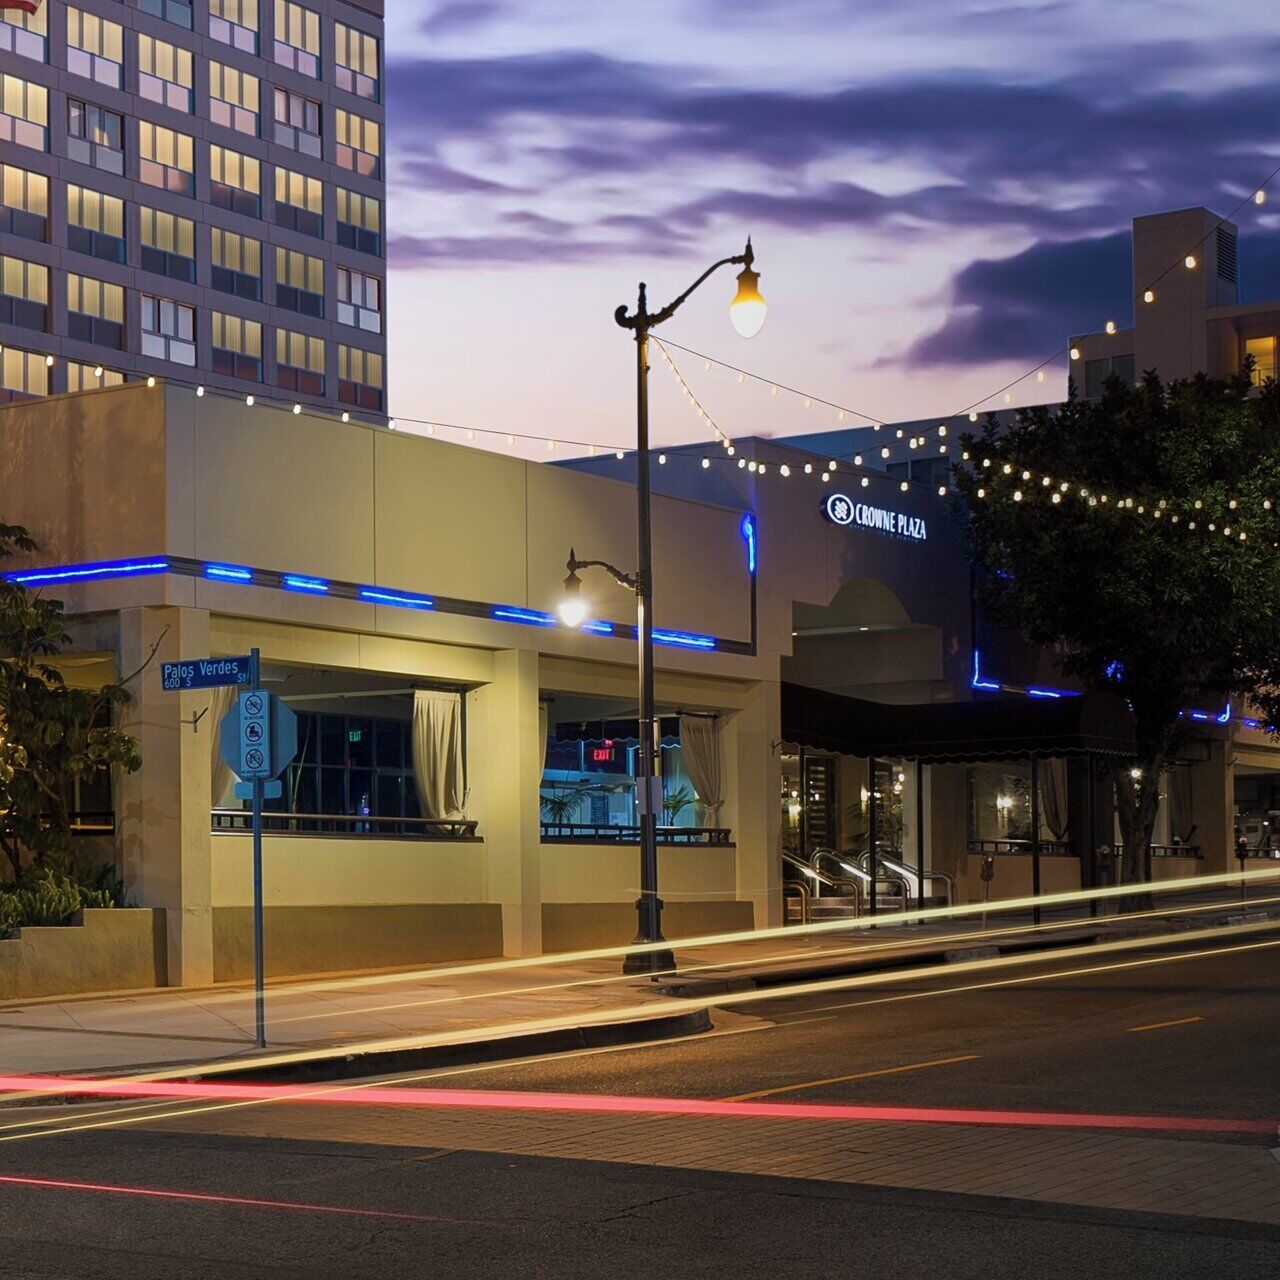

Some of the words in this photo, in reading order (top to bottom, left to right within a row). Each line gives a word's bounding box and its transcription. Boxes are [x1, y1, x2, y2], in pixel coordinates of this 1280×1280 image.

[855, 503, 896, 533] CROWNE
[897, 513, 927, 540] PLAZA
[164, 664, 194, 679] Palos
[199, 660, 238, 677] Verdes
[164, 678, 181, 689] 600
[186, 677, 192, 687] S
[237, 673, 246, 683] St
[594, 749, 610, 760] EXIT
